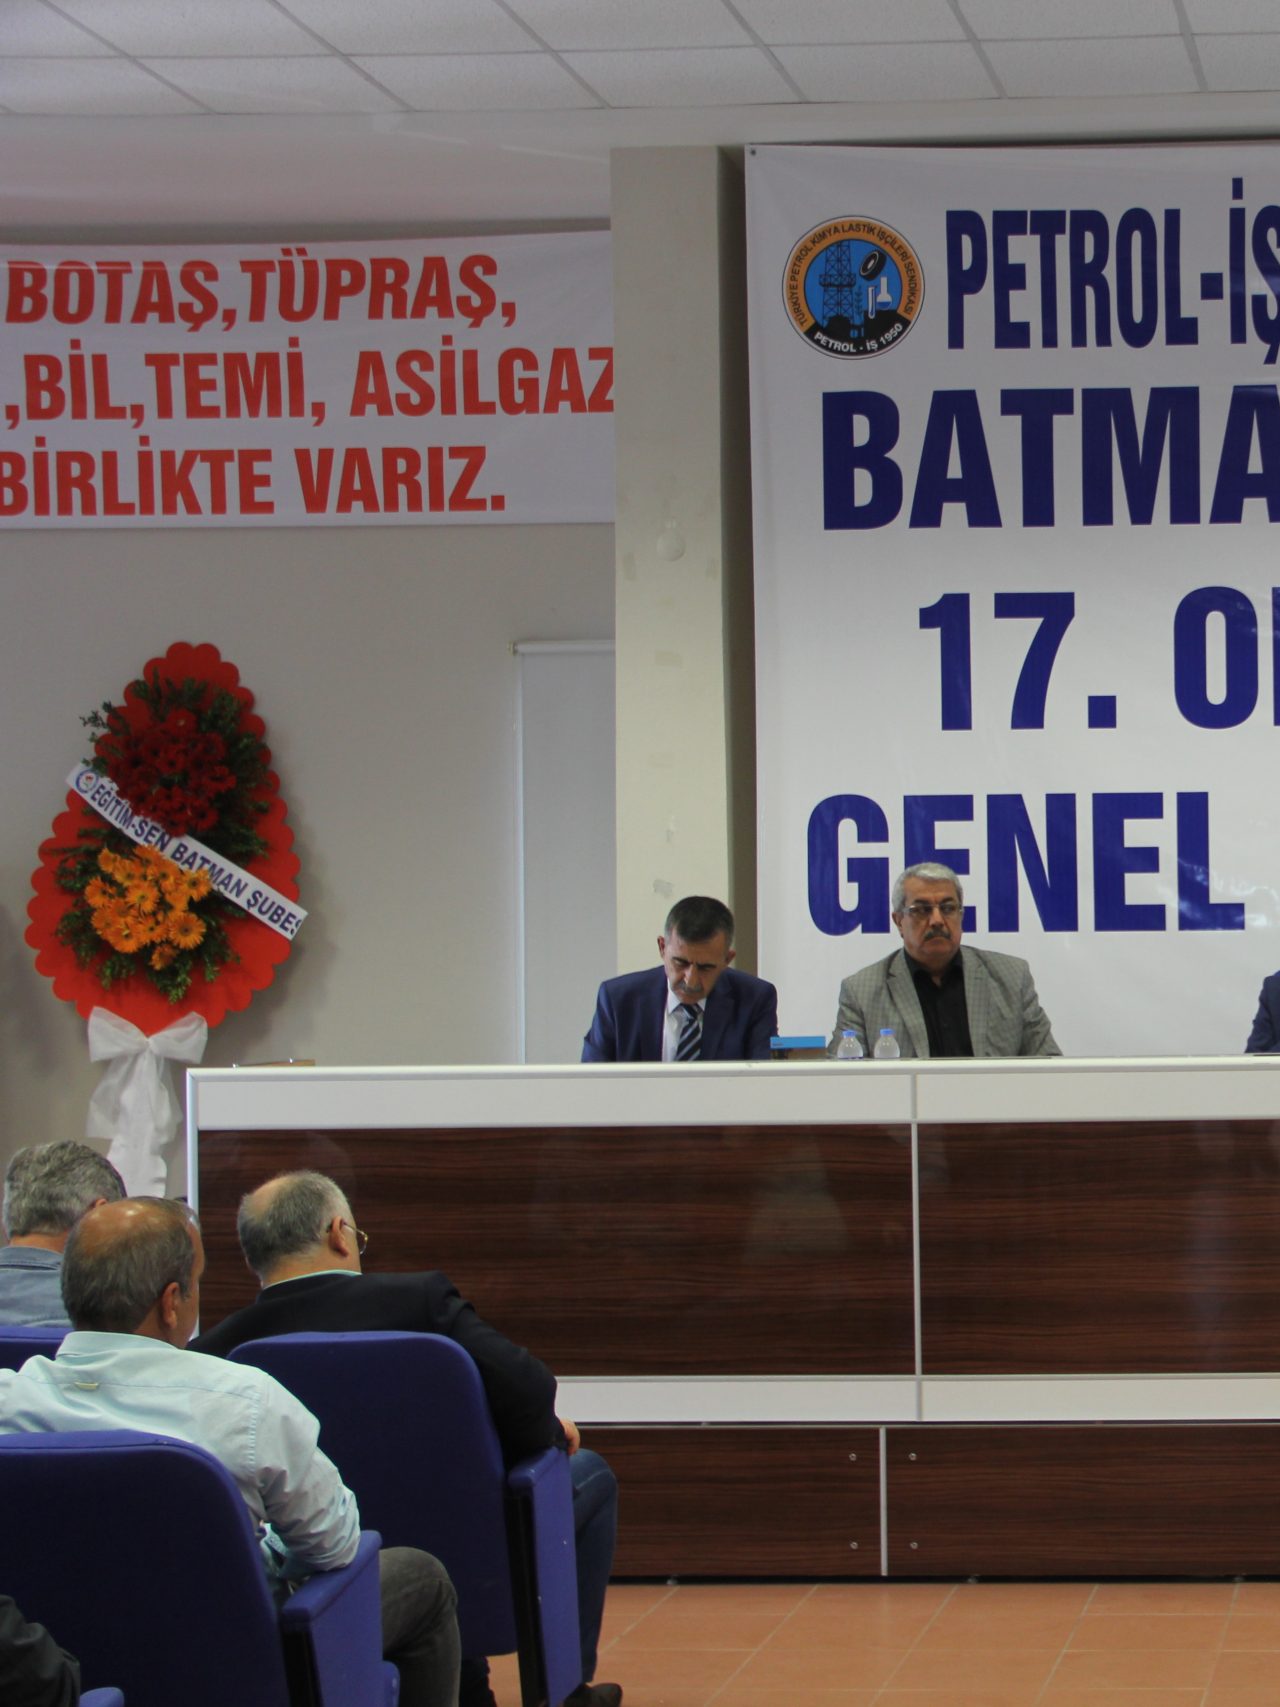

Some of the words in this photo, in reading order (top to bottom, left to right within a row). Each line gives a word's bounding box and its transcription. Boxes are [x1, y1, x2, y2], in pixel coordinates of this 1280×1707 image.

[811, 224, 840, 246] KİMYA
[841, 223, 876, 235] LASTİK
[790, 245, 813, 283] PETROL
[789, 283, 808, 326] TÜRKİYE
[813, 331, 857, 352] PETROL
[879, 323, 904, 345] 1950
[349, 334, 613, 417] ASİLGAZ
[0, 435, 275, 517] BİRLİKTE
[294, 445, 505, 514] VARIZ.
[919, 592, 1117, 730] 17.
[171, 843, 248, 898] BATMAN
[807, 792, 1245, 937] GENEL
